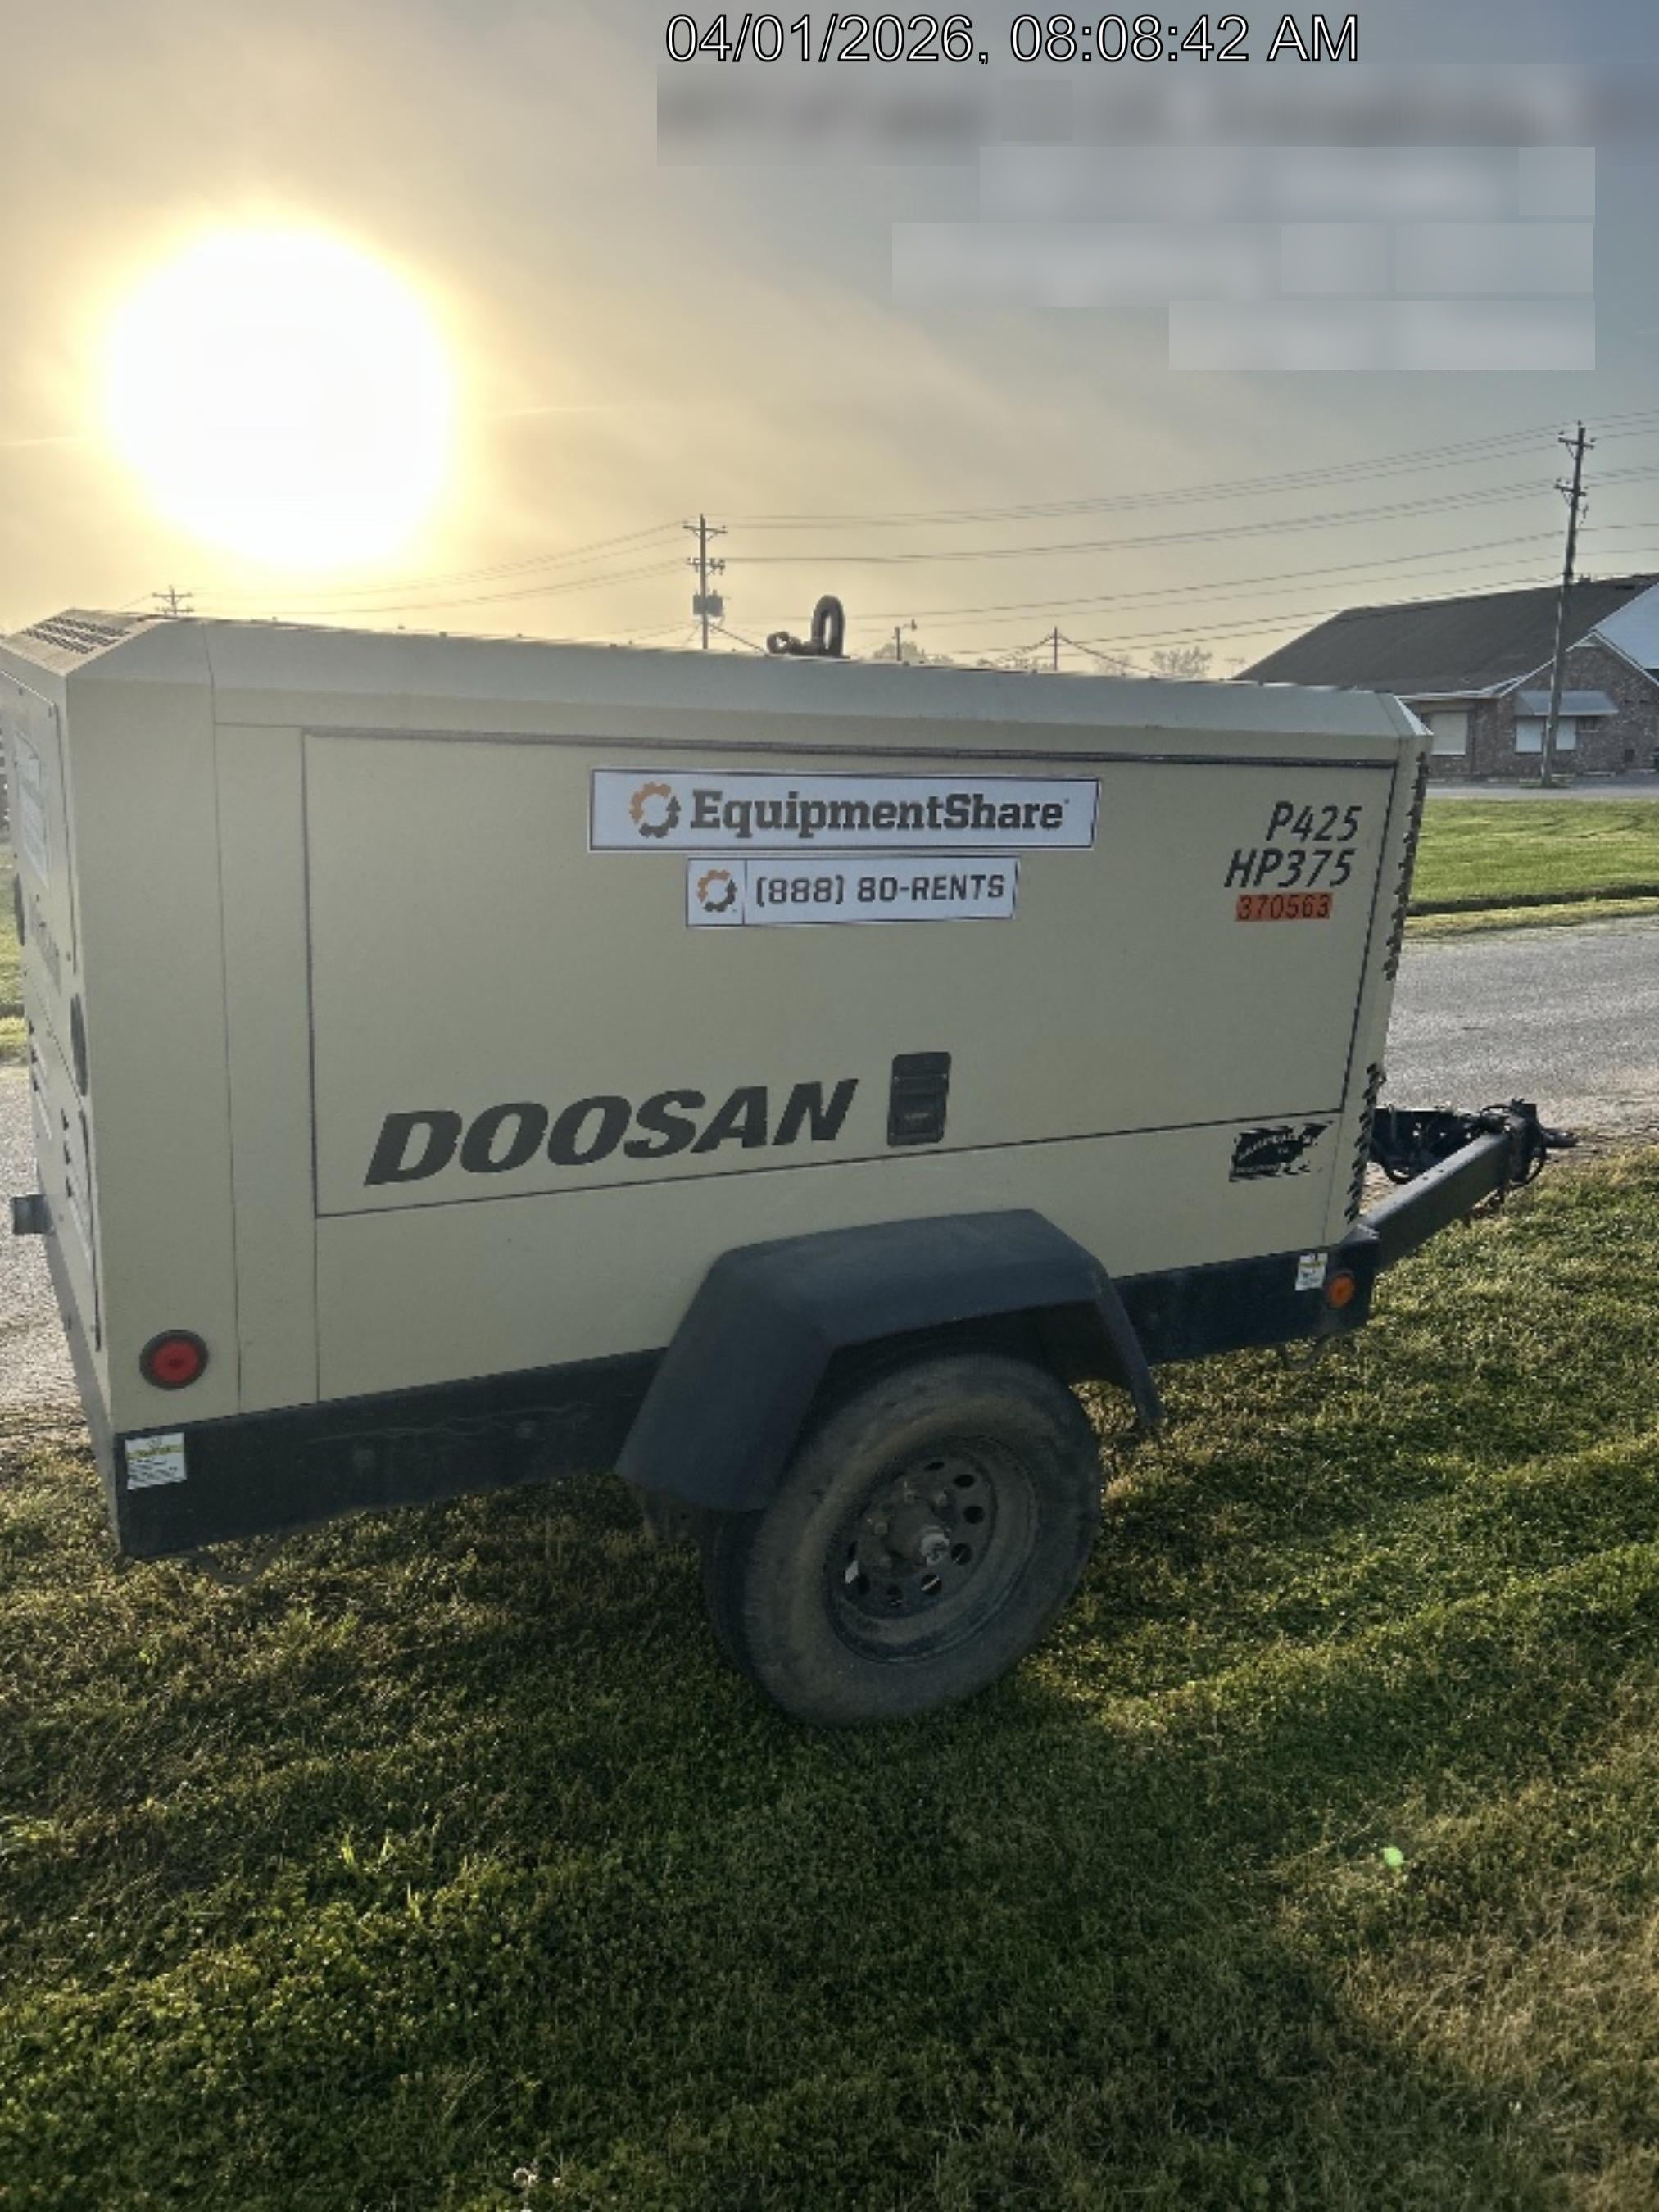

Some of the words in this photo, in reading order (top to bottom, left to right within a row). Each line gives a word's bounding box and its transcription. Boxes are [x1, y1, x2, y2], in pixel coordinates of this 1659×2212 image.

[690, 789, 1063, 839] EquipmentShare
[1266, 800, 1362, 842] P425
[1224, 848, 1356, 887] HP375
[756, 876, 845, 908] (888)
[857, 873, 1004, 902] 80-RENTS
[1237, 894, 1330, 921] 370563
[363, 1078, 859, 1186] DOOSAN
